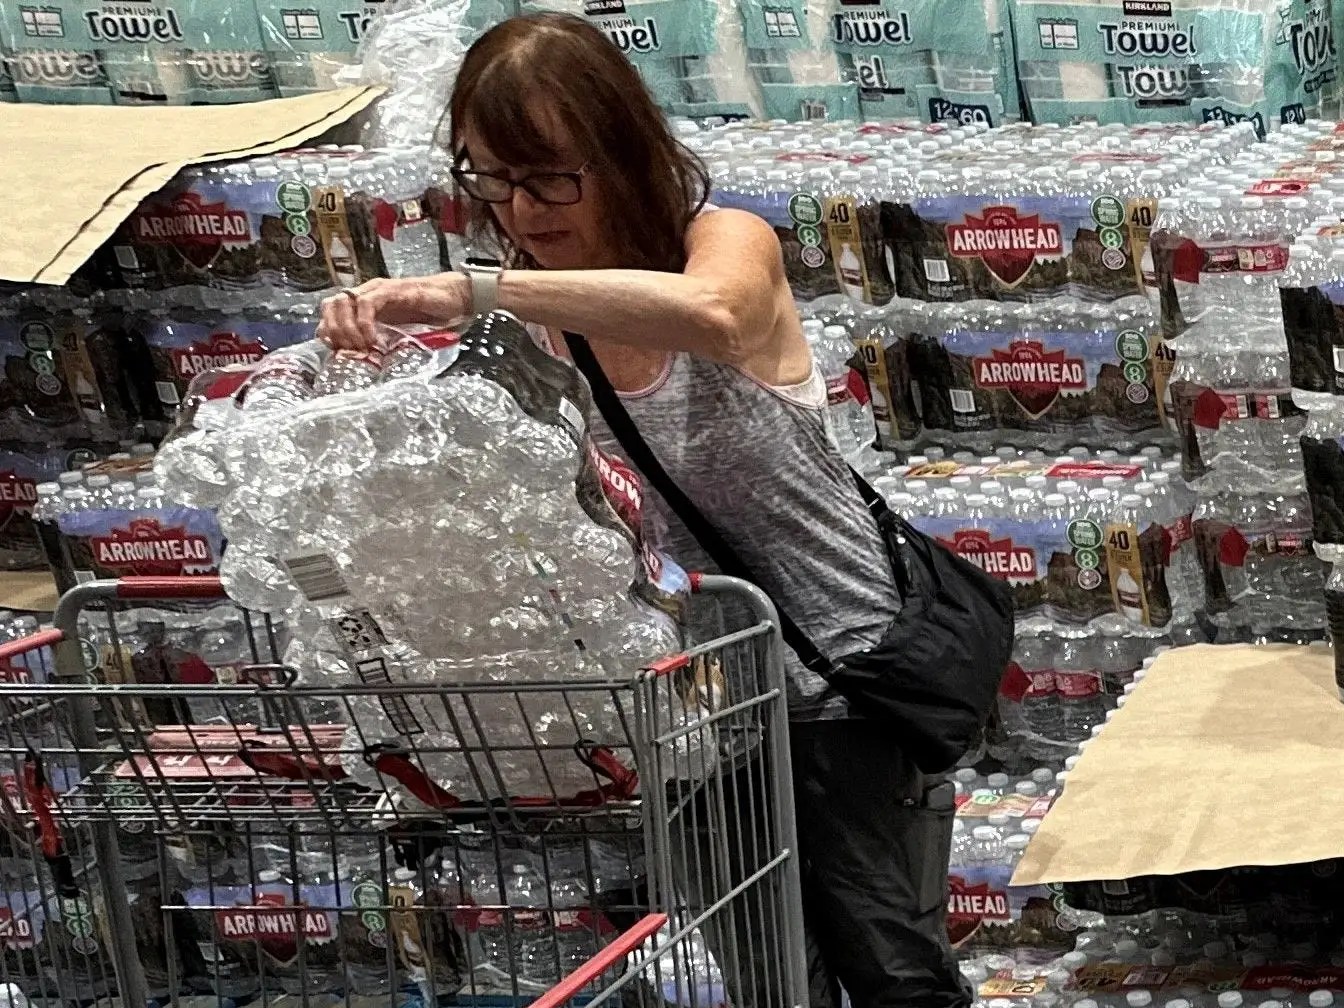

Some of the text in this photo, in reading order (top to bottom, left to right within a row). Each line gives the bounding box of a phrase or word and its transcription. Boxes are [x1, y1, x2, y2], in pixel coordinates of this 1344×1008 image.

[86, 9, 182, 41] Towel
[1099, 23, 1196, 58] Towel
[318, 191, 336, 212] 40
[829, 203, 850, 224] 40
[1131, 206, 1152, 227] 40
[139, 213, 249, 238] ARROWHEAD
[953, 228, 1058, 251] ARROWHEAD
[981, 361, 1082, 384] ARROWHEAD
[100, 539, 208, 564] ARROWHEAD
[1108, 531, 1130, 551] 40
